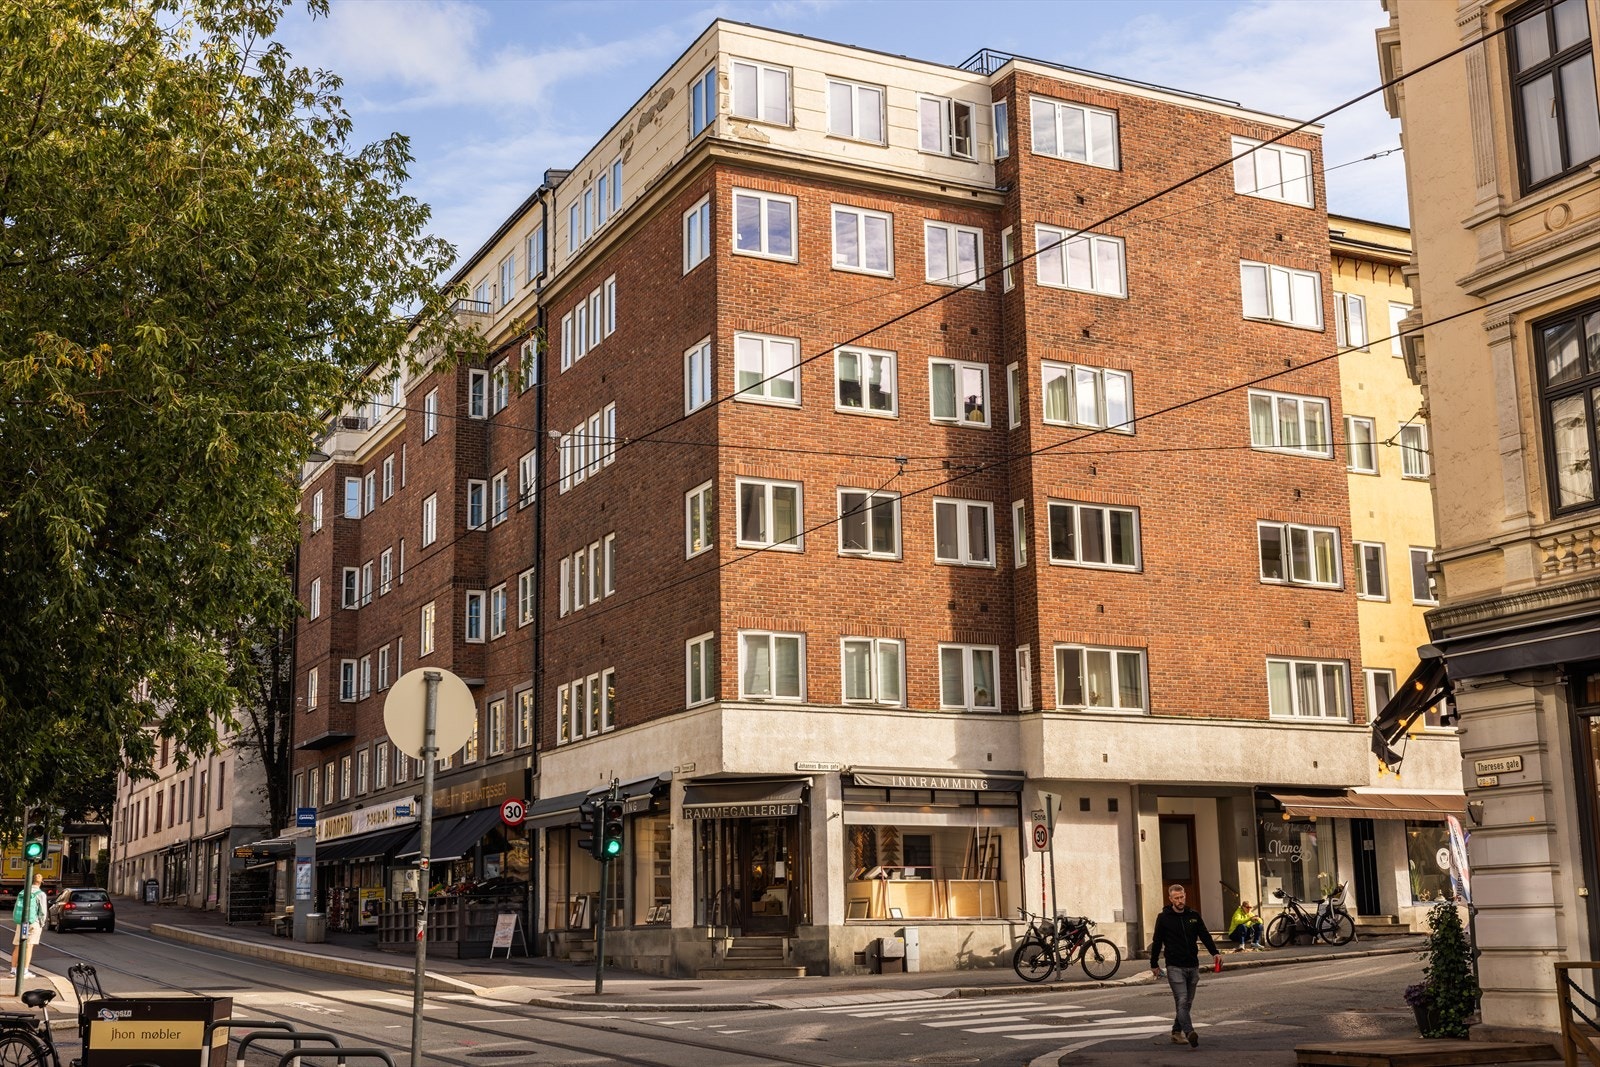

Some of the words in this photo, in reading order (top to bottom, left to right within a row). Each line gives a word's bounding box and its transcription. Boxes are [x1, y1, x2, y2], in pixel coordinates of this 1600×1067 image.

[1477, 762, 1504, 771] Thereses
[1506, 760, 1519, 770] gate
[892, 776, 989, 790] INNRAMMING
[505, 805, 521, 818] 30
[685, 804, 796, 819] RAMMEGALLERIET
[1034, 813, 1046, 821] Sone
[1036, 830, 1045, 842] 30
[1268, 839, 1312, 863] Nancy
[110, 1028, 136, 1041] jhon
[141, 1028, 181, 1039] møbler
